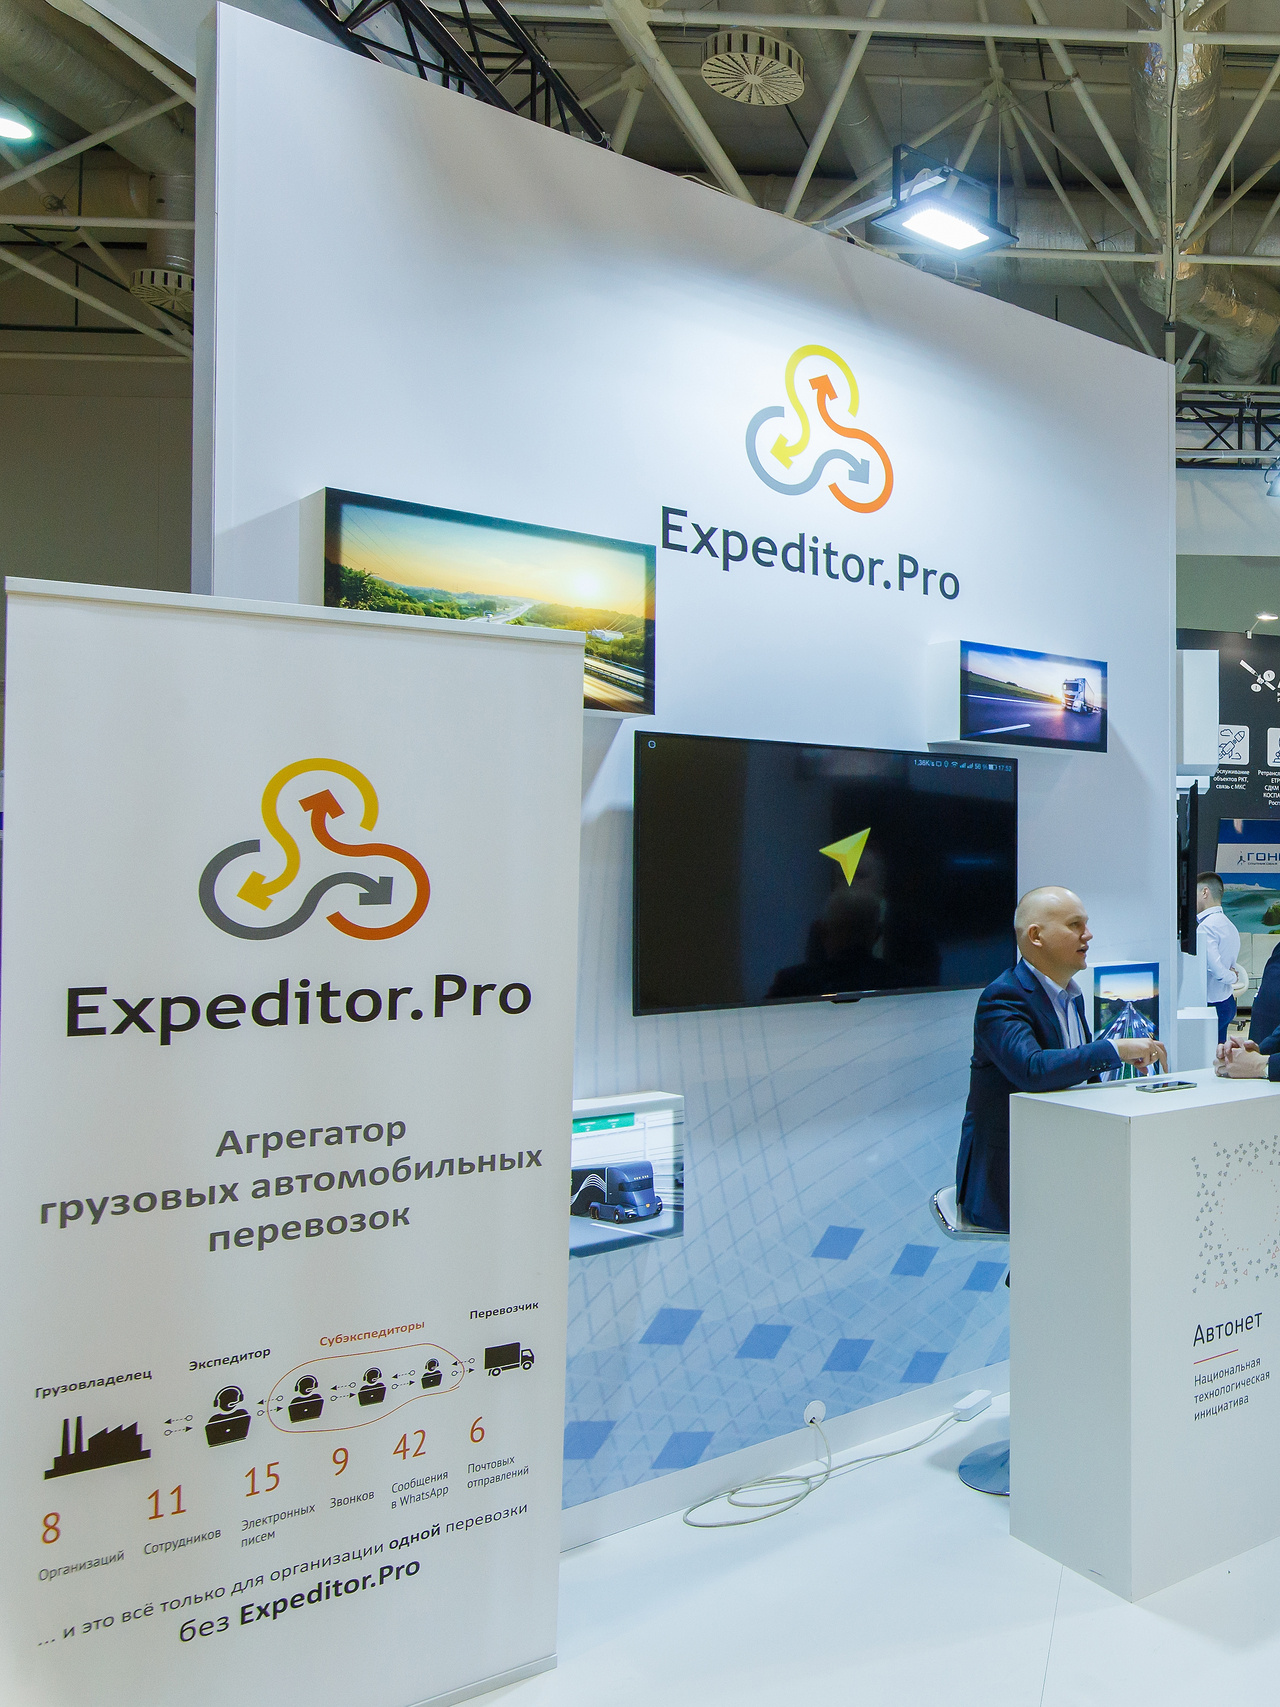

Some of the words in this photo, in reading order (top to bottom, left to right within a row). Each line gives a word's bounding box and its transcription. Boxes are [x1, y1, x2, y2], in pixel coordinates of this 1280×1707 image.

[661, 505, 960, 600] Expeditor.Pro
[1216, 768, 1250, 776] бслуживание
[66, 973, 532, 1046] Expeditor.Pro
[215, 1119, 407, 1159] Агрегатор
[39, 1180, 240, 1229] грузовых
[251, 1146, 543, 1200] автомобильных
[208, 1203, 411, 1252] перевозок
[469, 1300, 540, 1321] Перевозчик
[319, 1319, 426, 1348] Субэкспедиторы
[1193, 1311, 1263, 1347] Автонет
[188, 1347, 272, 1372] Экспедитор
[1194, 1356, 1262, 1387] Национальная
[35, 1367, 153, 1399] Грузовладелец
[1194, 1370, 1271, 1404] технологическая
[1194, 1394, 1249, 1422] инициатива
[392, 1428, 427, 1461] 42
[468, 1416, 486, 1444] 6
[331, 1446, 350, 1476] 9
[466, 1453, 516, 1475] Почтовых
[244, 1461, 282, 1497] 15
[390, 1468, 449, 1495] Сообщения
[466, 1464, 530, 1490] отправлений
[146, 1484, 188, 1521] 11
[329, 1489, 375, 1510] Звонков
[390, 1500, 398, 1510] в
[399, 1485, 450, 1509] WhatsApp
[40, 1511, 62, 1544] 8
[240, 1501, 316, 1532] Электронных
[143, 1527, 222, 1558] Сотрудников
[240, 1528, 276, 1550] писем
[37, 1547, 126, 1582] Организаций
[62, 1625, 76, 1641] и
[81, 1614, 116, 1635] это
[121, 1602, 156, 1625] всё
[159, 1584, 227, 1614] только
[230, 1573, 265, 1600] для
[269, 1541, 385, 1582] организации
[388, 1523, 442, 1551] одной
[445, 1503, 529, 1536] перевозки
[178, 1610, 231, 1644] без
[238, 1557, 422, 1627] Expeditor.Pro
